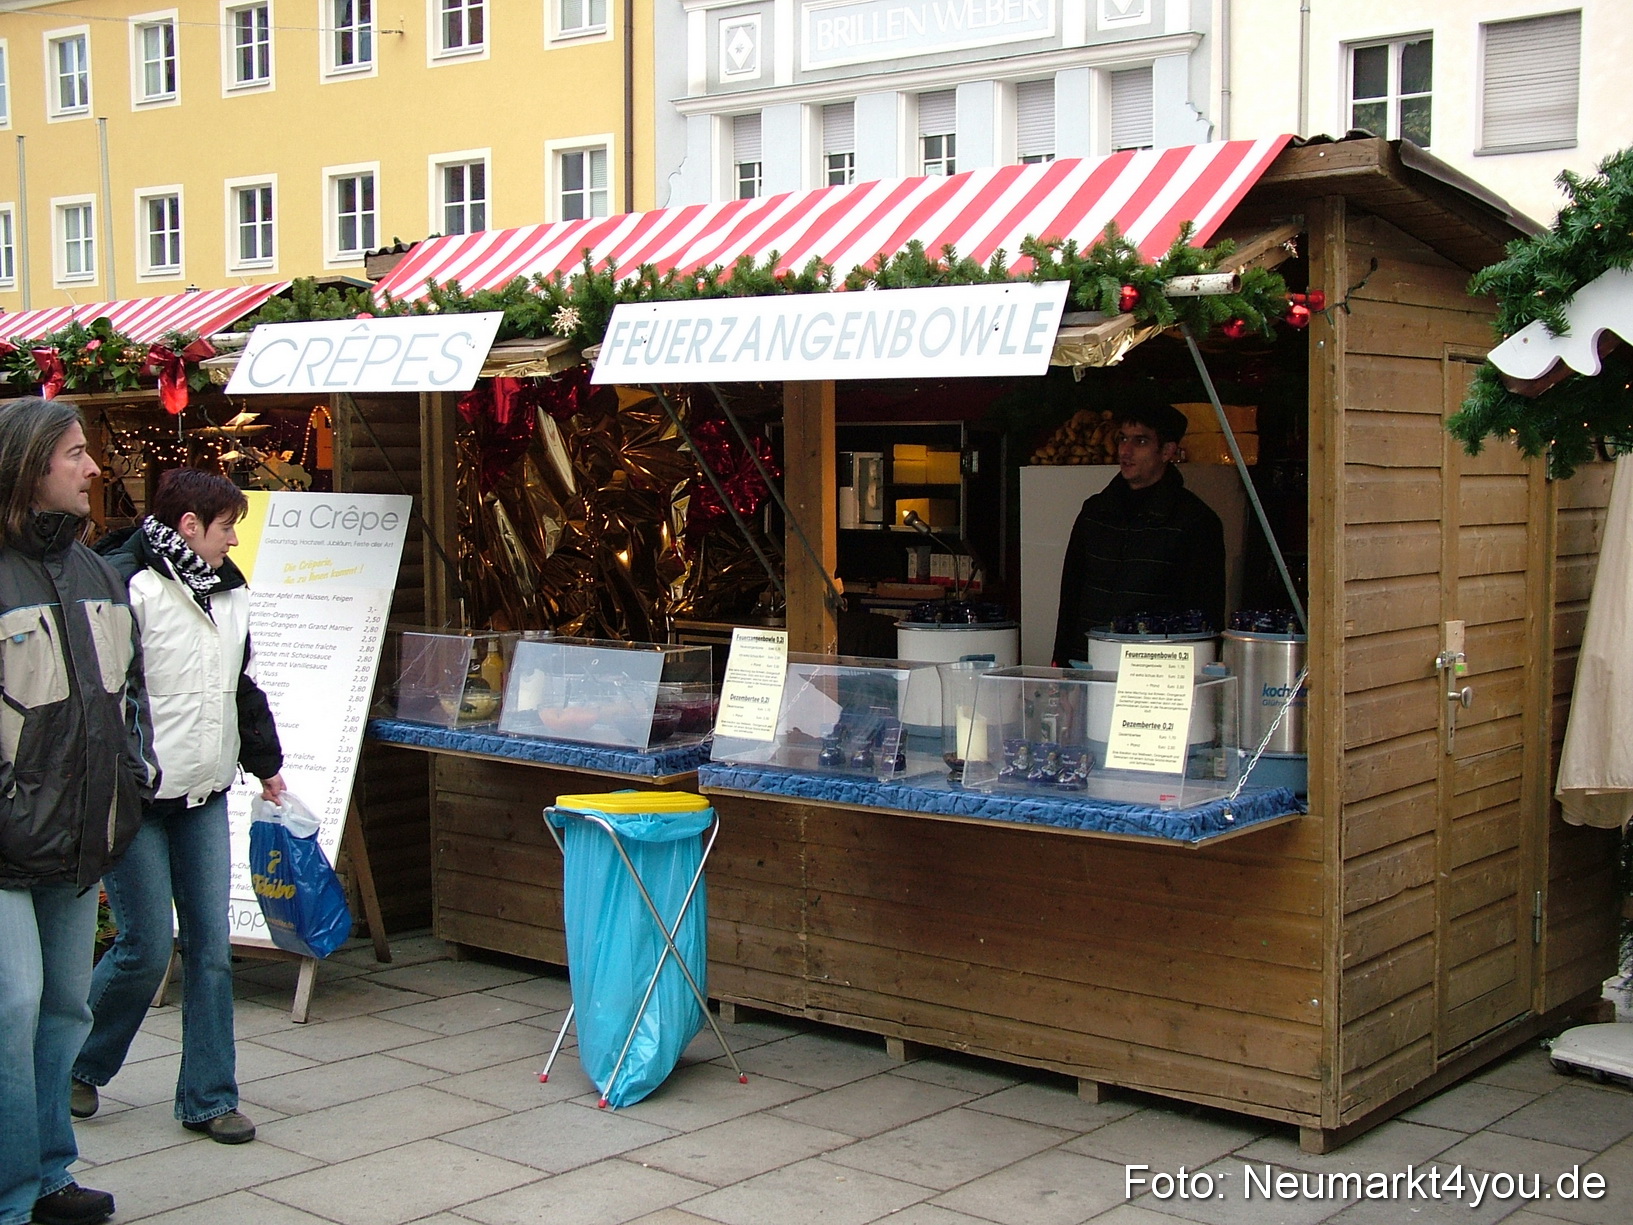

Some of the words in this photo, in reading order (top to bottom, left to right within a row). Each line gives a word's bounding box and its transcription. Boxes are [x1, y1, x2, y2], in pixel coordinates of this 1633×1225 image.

[816, 5, 926, 50] BRILLEN
[932, 0, 1044, 32] WEBER
[603, 301, 1055, 366] FEUERZANGENBOWLE
[248, 322, 472, 387] CRÊPES
[268, 503, 302, 528] La
[310, 504, 399, 536] Crêpe
[354, 540, 369, 548] Feste
[276, 592, 292, 600] Apfel
[332, 595, 354, 603] Feigen
[365, 616, 381, 624] 2,50
[248, 621, 297, 630] arillen-Orangen
[328, 624, 354, 632] Marnier
[291, 652, 332, 660] Schokosauce
[1125, 650, 1177, 660] Feuerzangenbowle
[260, 680, 290, 688] Amaretto
[730, 693, 760, 702] Dezembertee
[1122, 719, 1161, 730] Dezembertee
[336, 756, 352, 764] 2,50
[334, 766, 350, 774] 2,50
[228, 904, 266, 932] App
